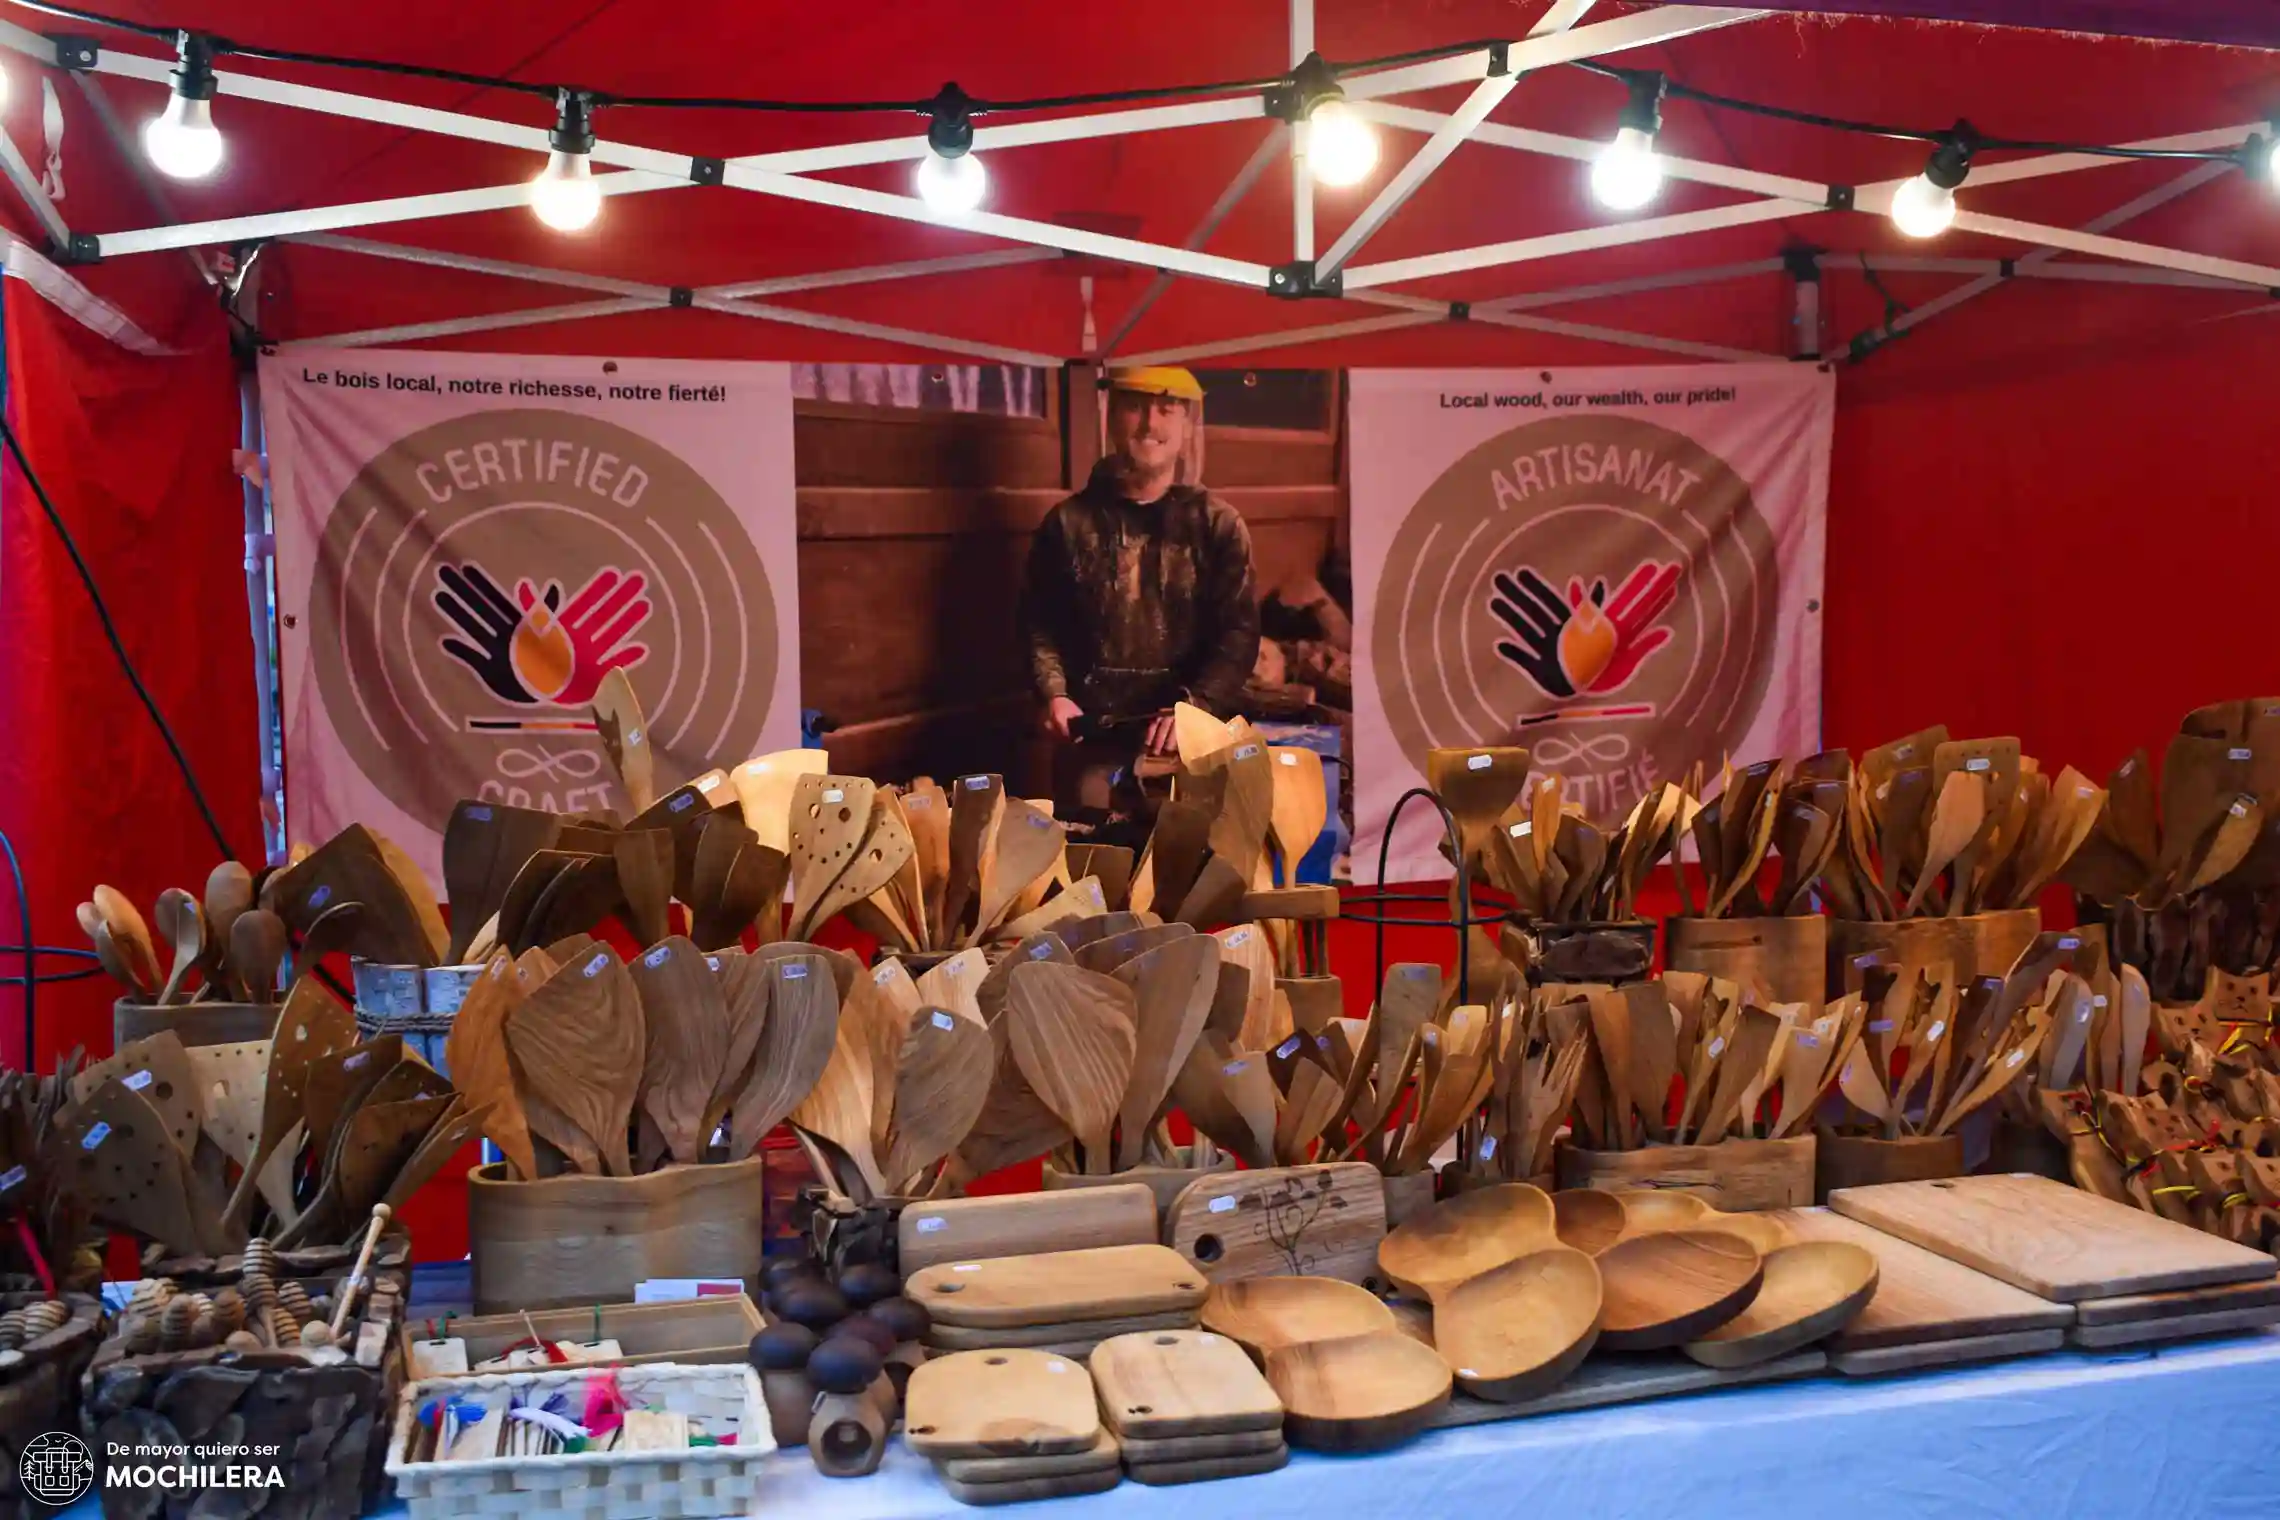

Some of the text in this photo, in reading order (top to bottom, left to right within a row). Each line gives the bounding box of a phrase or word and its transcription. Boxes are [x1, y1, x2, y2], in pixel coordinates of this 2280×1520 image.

[303, 368, 726, 402] Le bois local, notre richesse, notre fierté!
[1440, 386, 1736, 410] Local wood, our wealth, our pride!
[415, 438, 649, 508] CERTIFIED
[1490, 441, 1701, 512] ARTISANAT
